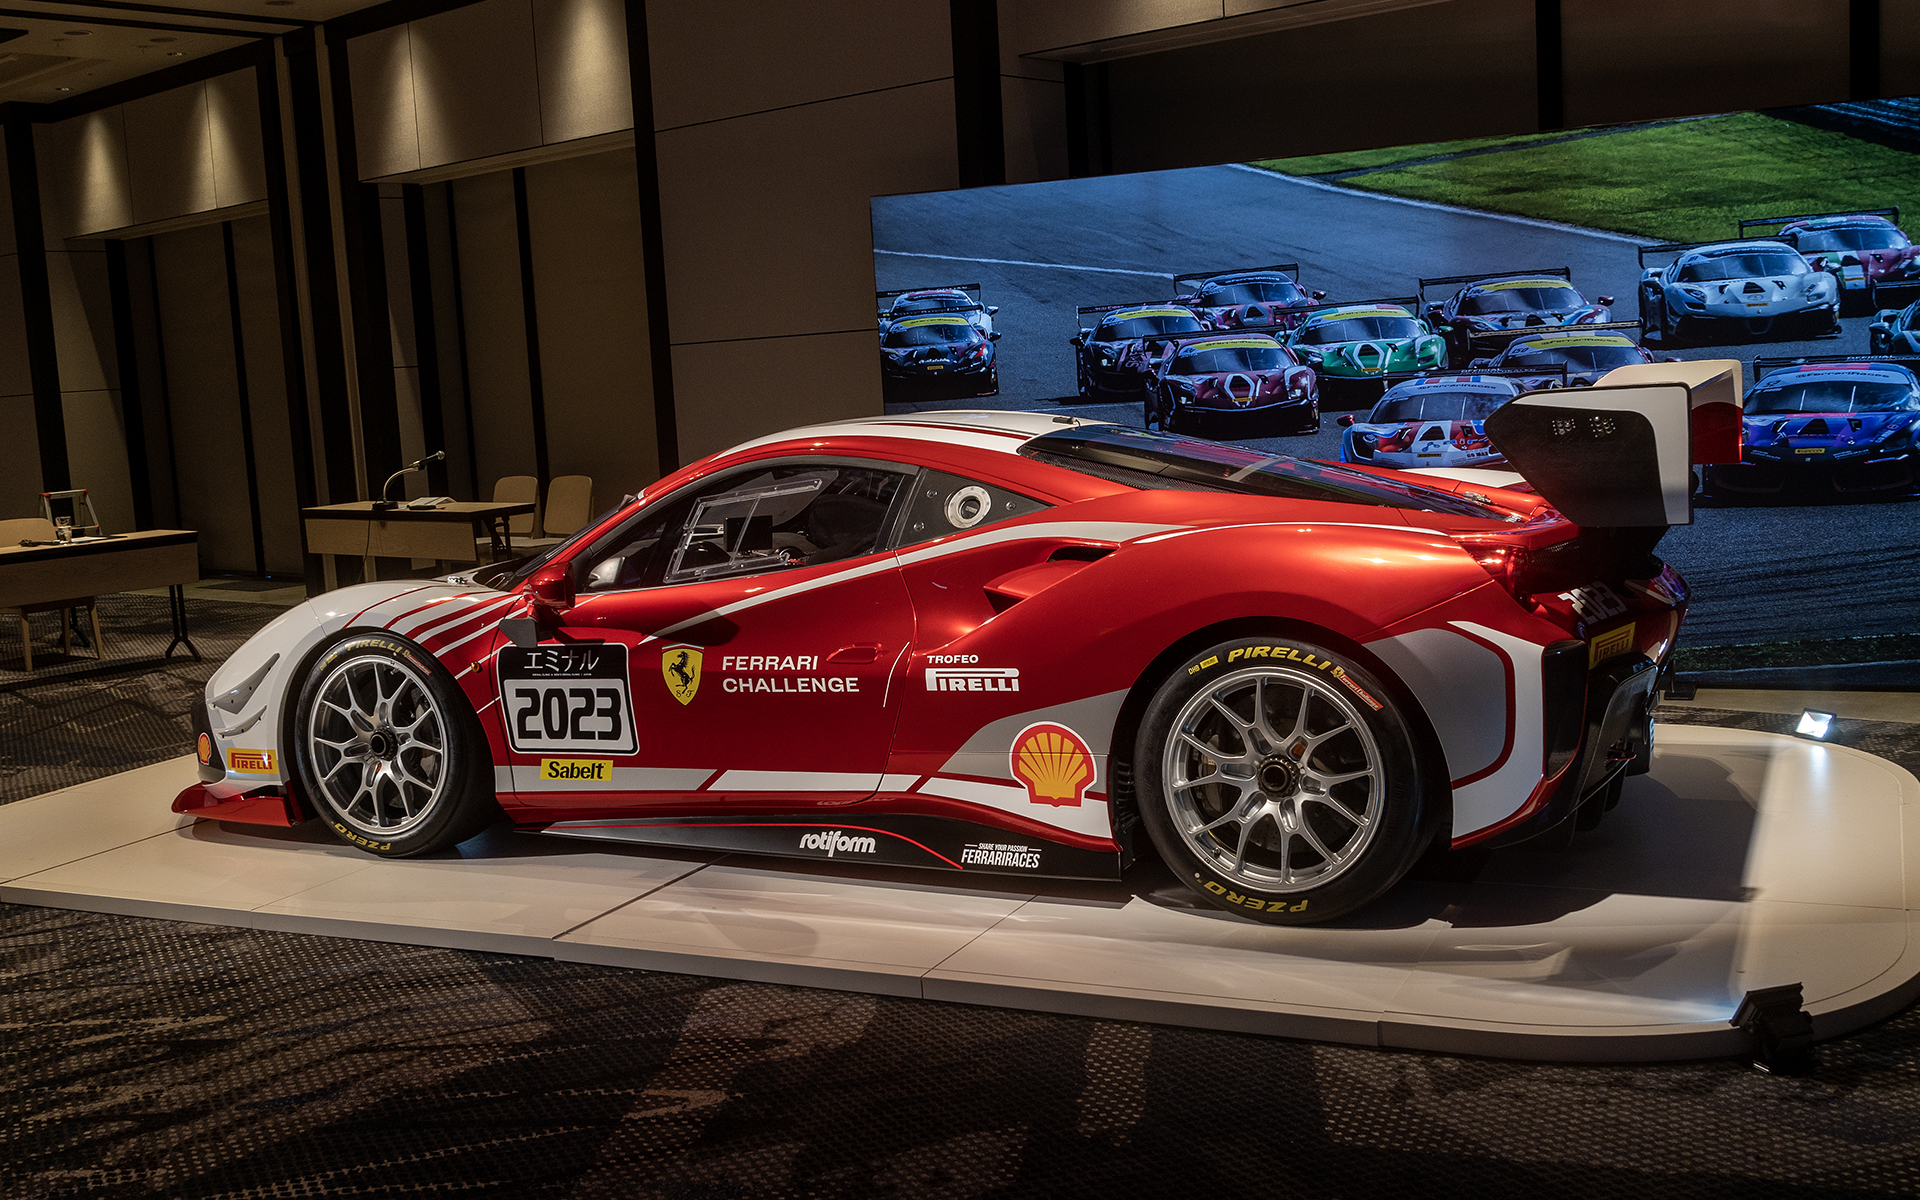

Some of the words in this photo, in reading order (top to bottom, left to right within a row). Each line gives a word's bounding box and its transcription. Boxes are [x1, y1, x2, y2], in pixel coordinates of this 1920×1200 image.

[1557, 580, 1628, 625] 2023
[344, 639, 403, 653] PIRELLI
[1593, 629, 1632, 662] PIRELLI
[523, 650, 600, 672] エミナル
[722, 655, 819, 671] FERRARI
[926, 654, 979, 664] TROFEO
[1227, 645, 1332, 671] PIRELLI
[722, 677, 860, 693] CHALLENGE
[925, 667, 1020, 692] PIRELLI
[515, 688, 622, 741] 2023
[231, 752, 273, 770] PIRELLI
[547, 761, 605, 780] Sabelt
[798, 830, 877, 858] rotiform
[978, 842, 995, 851] SHARE
[994, 843, 1008, 852] YOUR
[1007, 844, 1029, 853] PASSION
[960, 848, 1041, 869] FERRARIRACES
